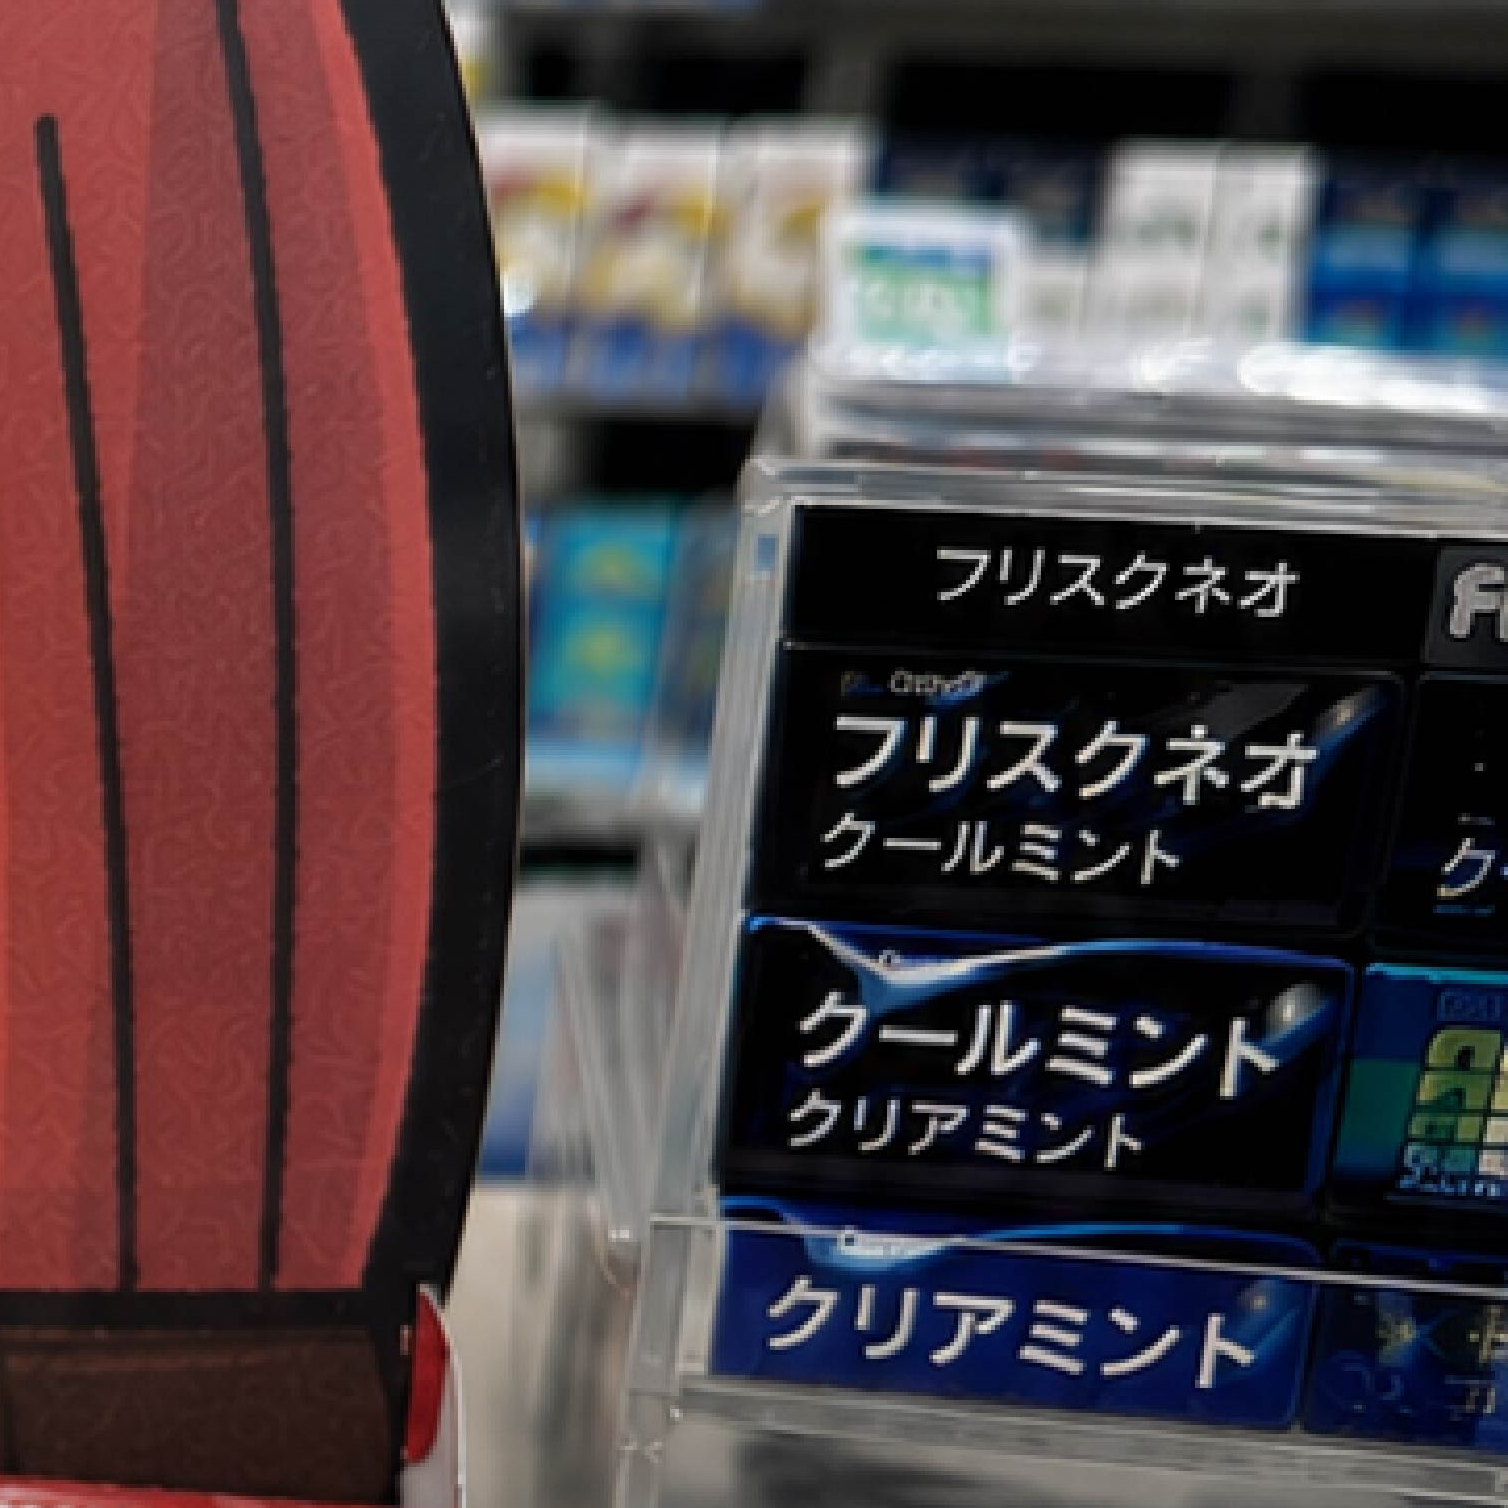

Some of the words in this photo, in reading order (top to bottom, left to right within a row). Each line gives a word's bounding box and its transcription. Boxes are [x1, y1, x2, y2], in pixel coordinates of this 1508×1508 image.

[936, 545, 1301, 621] フリスクネオ
[833, 712, 1319, 811] フリスクネオ
[822, 812, 1182, 885] クールミント
[799, 986, 1280, 1100] クールミント
[789, 1088, 1145, 1168] クリアミント
[765, 1273, 1259, 1387] クリアミント
